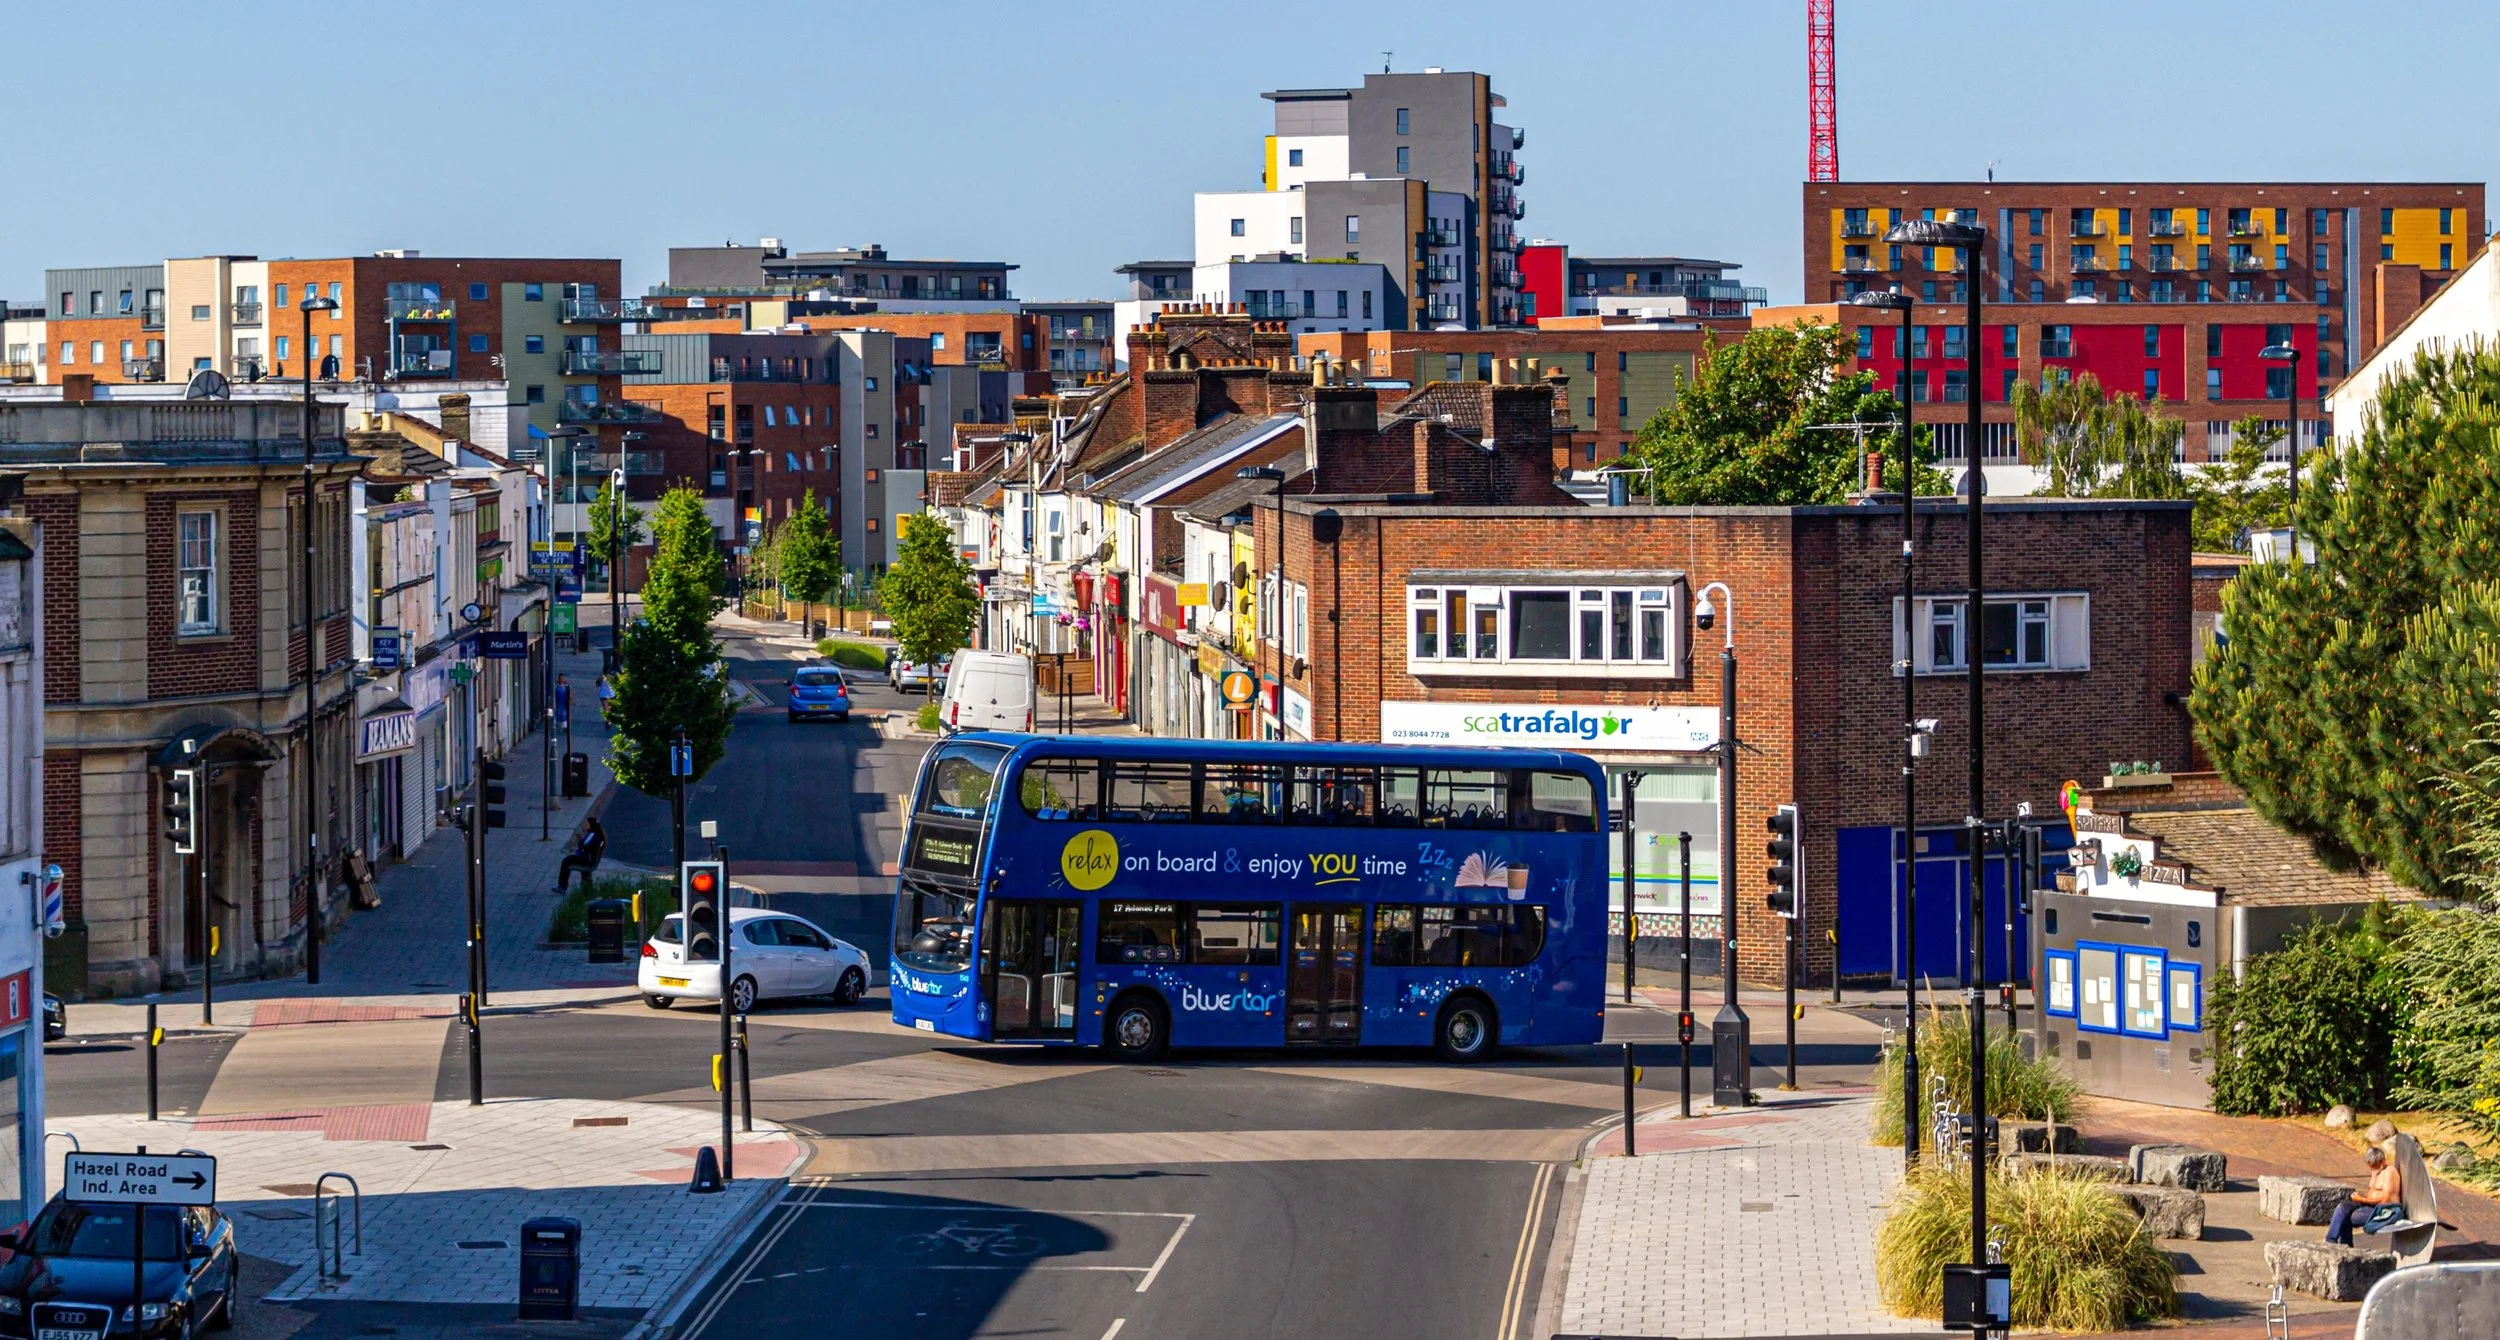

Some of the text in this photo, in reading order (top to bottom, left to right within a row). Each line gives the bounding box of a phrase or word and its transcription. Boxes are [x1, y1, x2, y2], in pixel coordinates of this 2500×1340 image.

[373, 647, 398, 655] CUTTING
[490, 641, 523, 649] Martin's
[1231, 675, 1246, 698] L
[368, 714, 415, 753] BEAMANS
[1392, 730, 1407, 738] 023
[1430, 731, 1450, 739] 7728
[1691, 733, 1708, 741] NHS
[2076, 813, 2117, 832] SPITFIRE
[1068, 837, 1407, 879] relax on board & enjoy YOU time
[2140, 865, 2181, 884] PIZZA
[1113, 904, 1123, 912] 17
[1154, 904, 1173, 912] Park
[911, 976, 942, 995] bluestar
[1182, 988, 1277, 1012] bluestar
[74, 1160, 167, 1177] Hazel Road
[82, 1179, 157, 1195] Ind. Area
